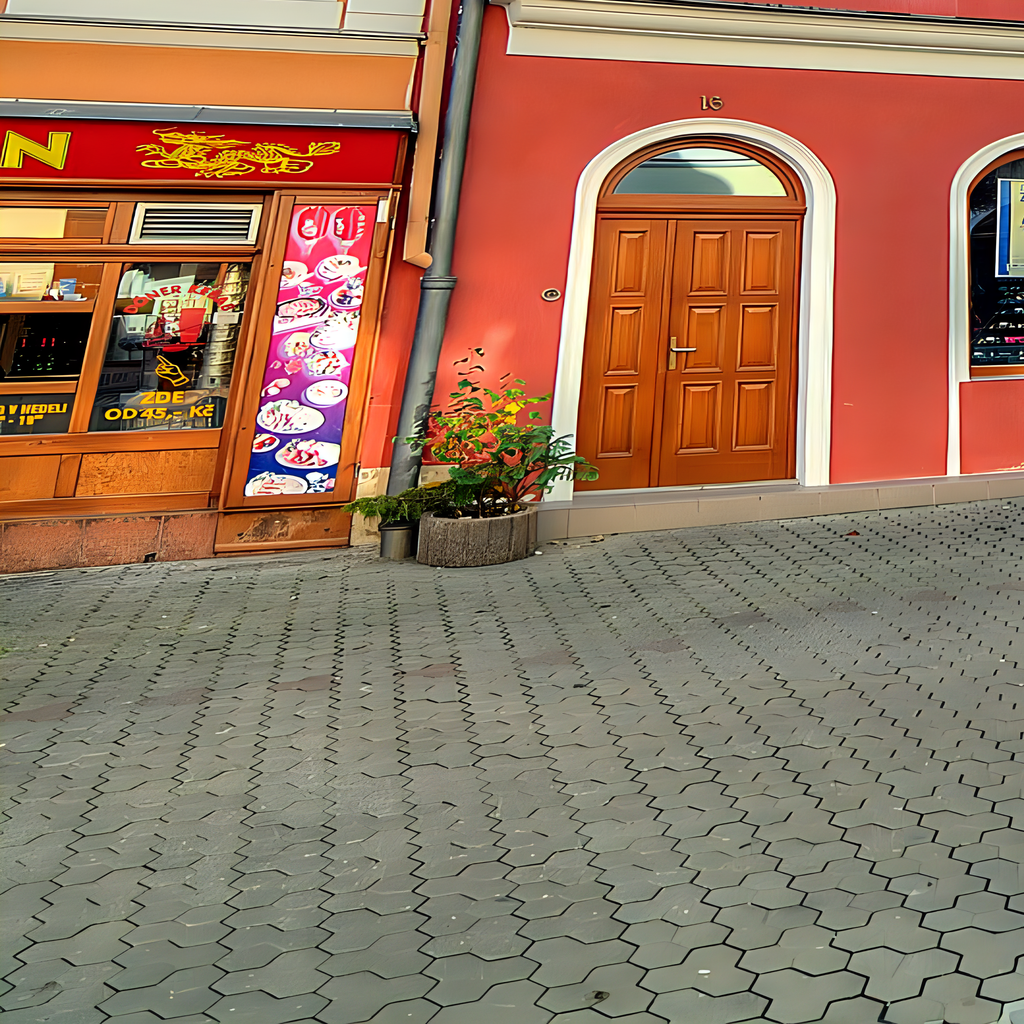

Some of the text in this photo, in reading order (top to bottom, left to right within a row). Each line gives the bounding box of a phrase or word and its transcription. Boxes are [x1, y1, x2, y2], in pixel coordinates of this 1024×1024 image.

[699, 95, 723, 110] 16
[140, 390, 185, 404] ZDE
[189, 403, 215, 418] Kč
